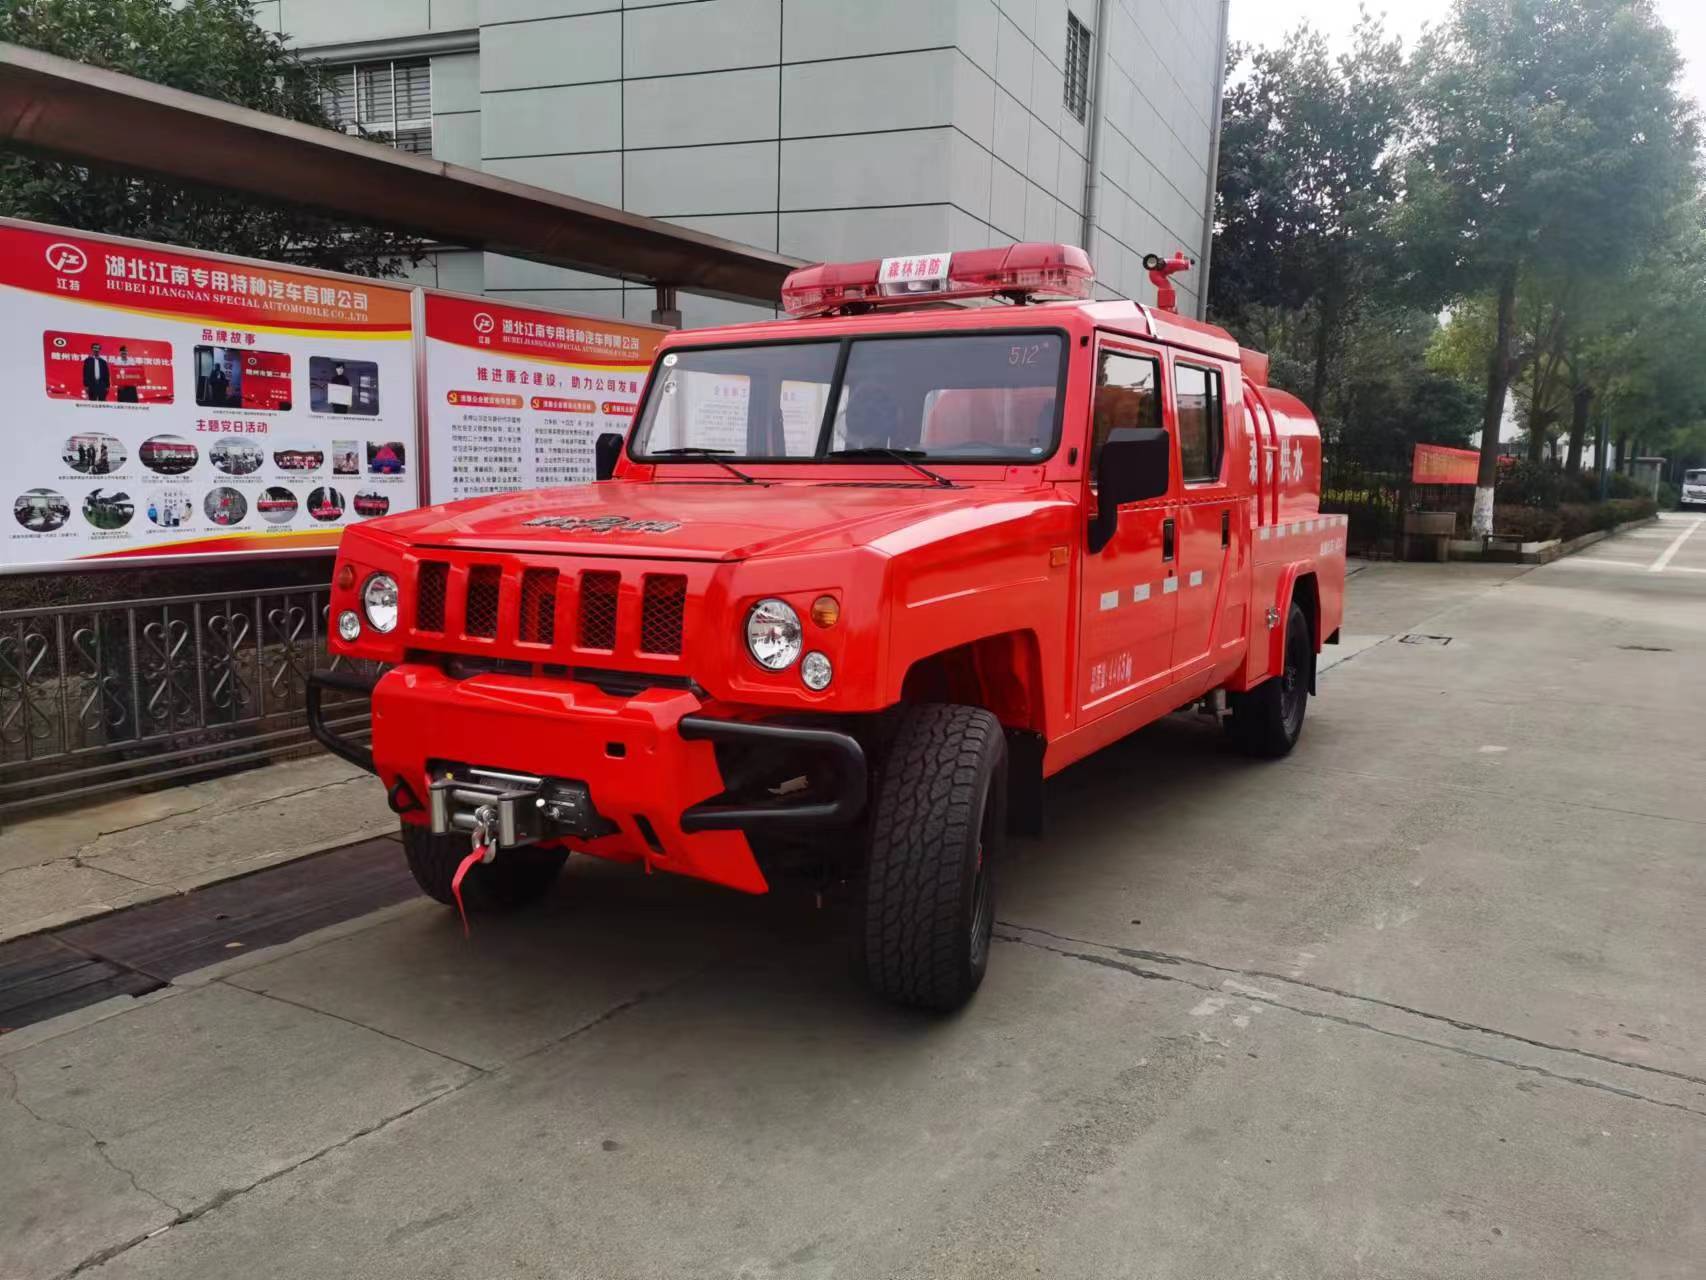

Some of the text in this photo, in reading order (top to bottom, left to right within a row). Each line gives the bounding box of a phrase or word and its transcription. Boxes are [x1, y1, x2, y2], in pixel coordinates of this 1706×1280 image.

[887, 258, 943, 279] 森林消防
[57, 277, 80, 292] 江特
[105, 254, 368, 312] 湖北江南专用特种汽车有限公司
[106, 279, 146, 294] HUBEI
[149, 285, 210, 302] JIANGNAN
[212, 293, 260, 309] SPECIAL
[262, 301, 329, 318] AUTOMOBILE
[202, 328, 256, 345] 品牌故事
[196, 419, 268, 434] 主题党日活动
